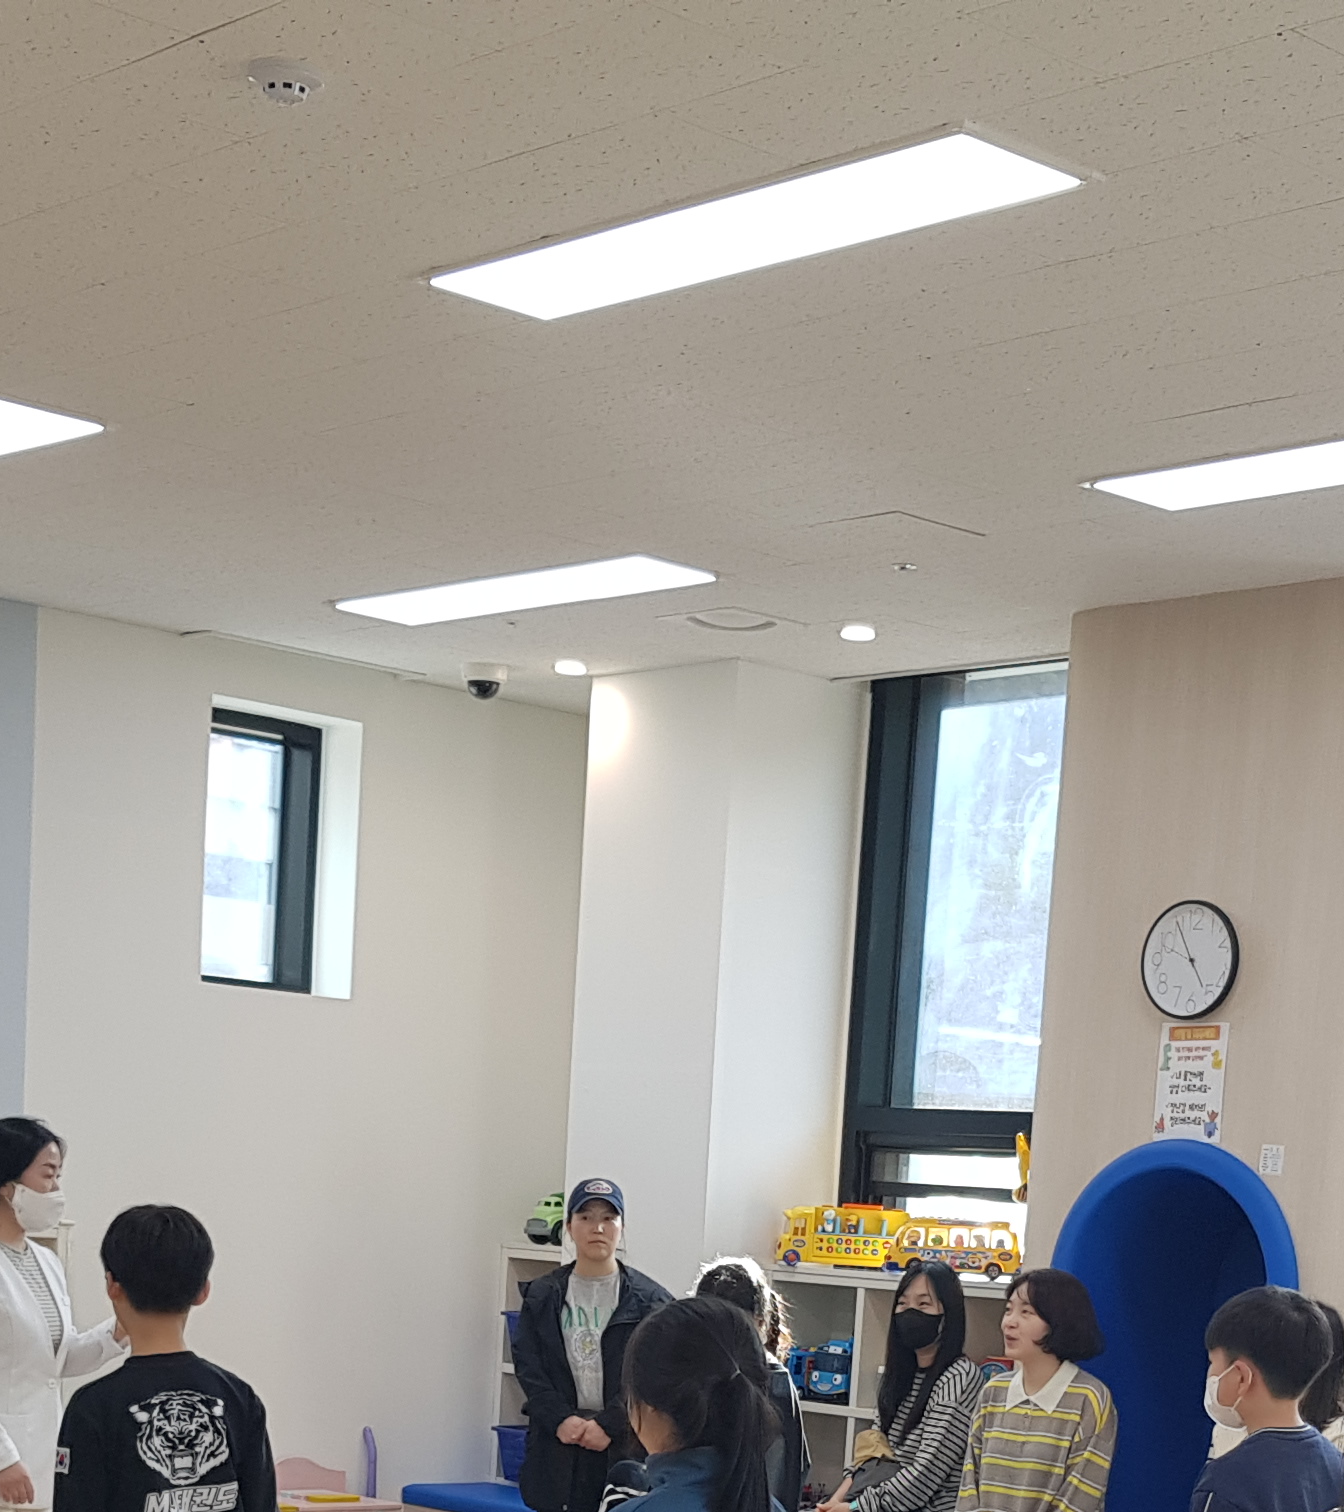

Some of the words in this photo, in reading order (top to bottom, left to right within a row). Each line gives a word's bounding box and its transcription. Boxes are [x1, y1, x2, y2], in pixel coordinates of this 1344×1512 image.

[1157, 972, 1168, 995] 8
[1173, 985, 1183, 1008] 7
[1185, 991, 1196, 1014] 6
